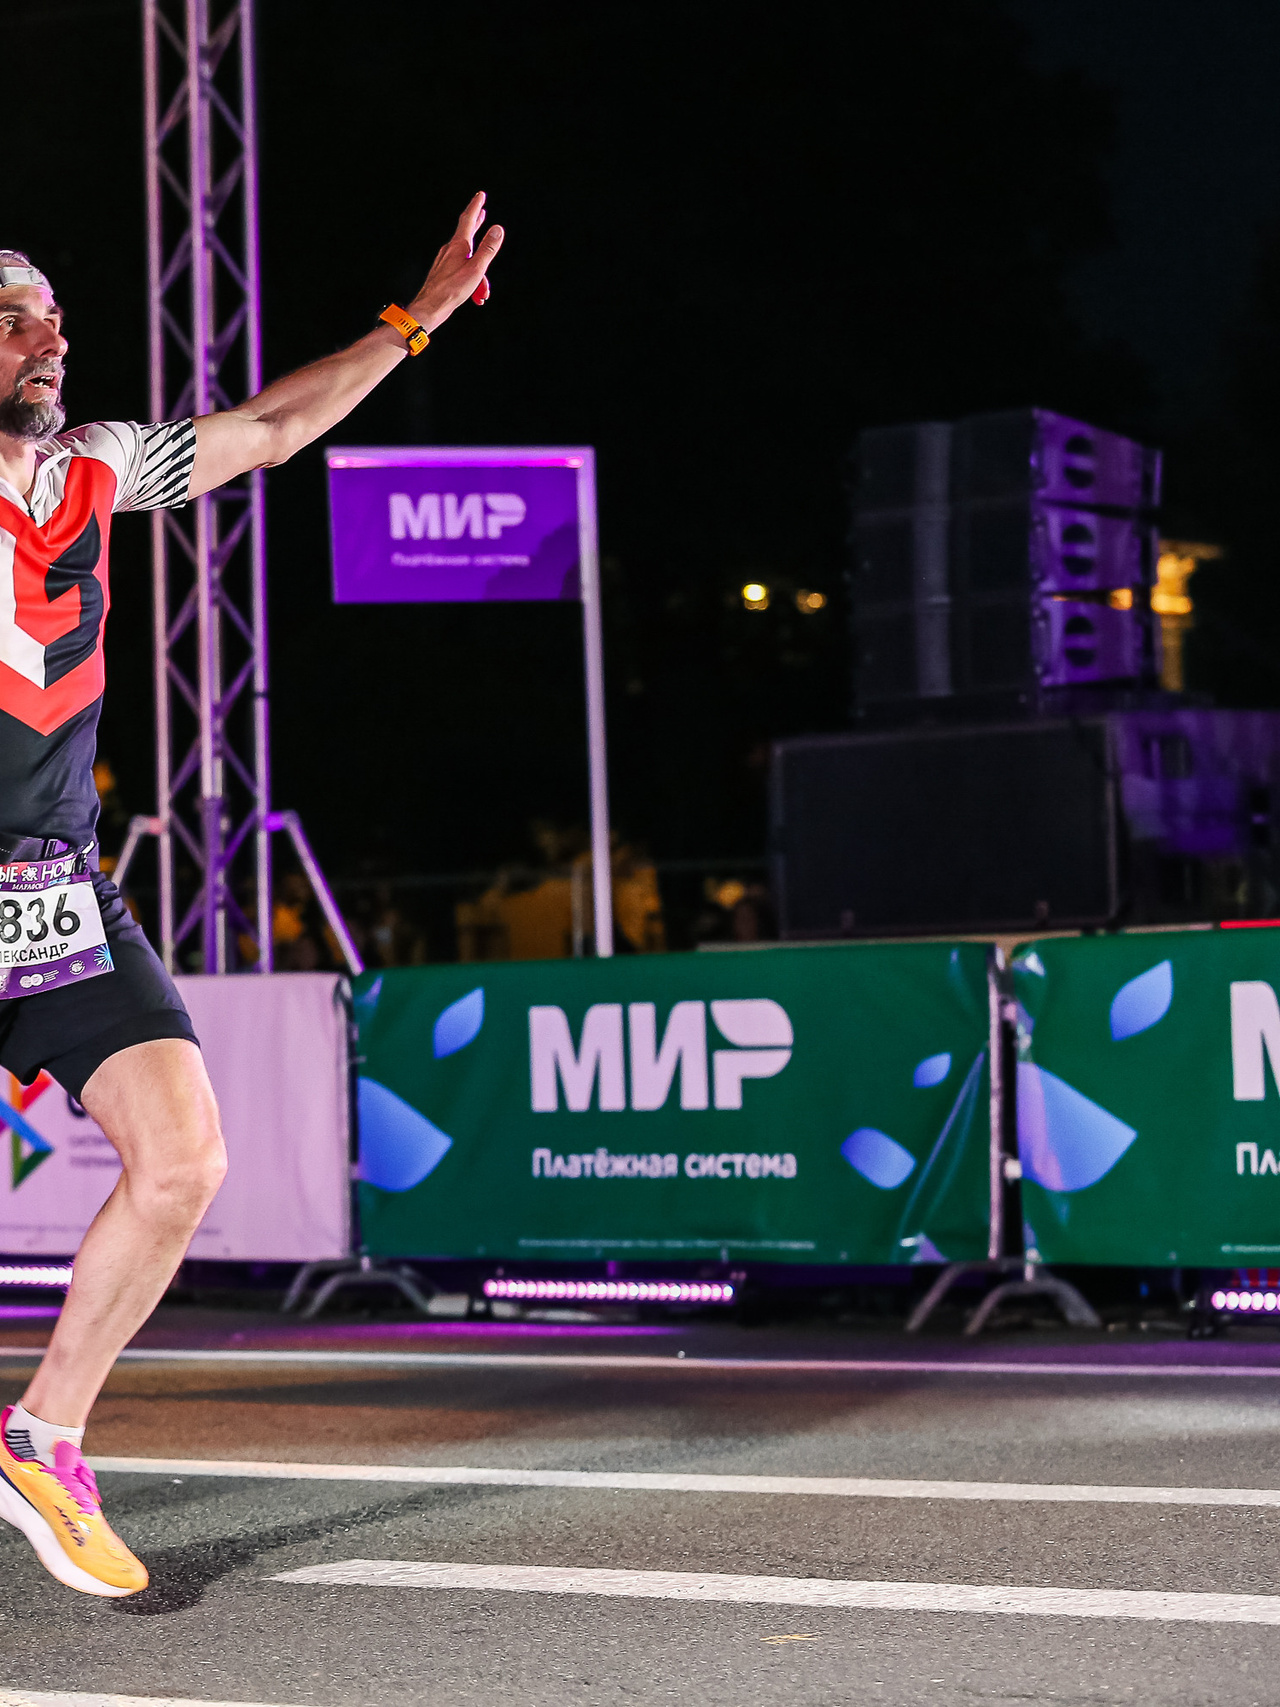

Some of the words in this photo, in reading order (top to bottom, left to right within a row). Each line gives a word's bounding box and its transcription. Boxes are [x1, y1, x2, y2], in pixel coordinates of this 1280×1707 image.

[388, 491, 527, 540] МИР
[528, 998, 794, 1113] МИР
[531, 1146, 679, 1179] Платёжная
[683, 1152, 798, 1179] система
[1235, 1141, 1280, 1176] Пл
